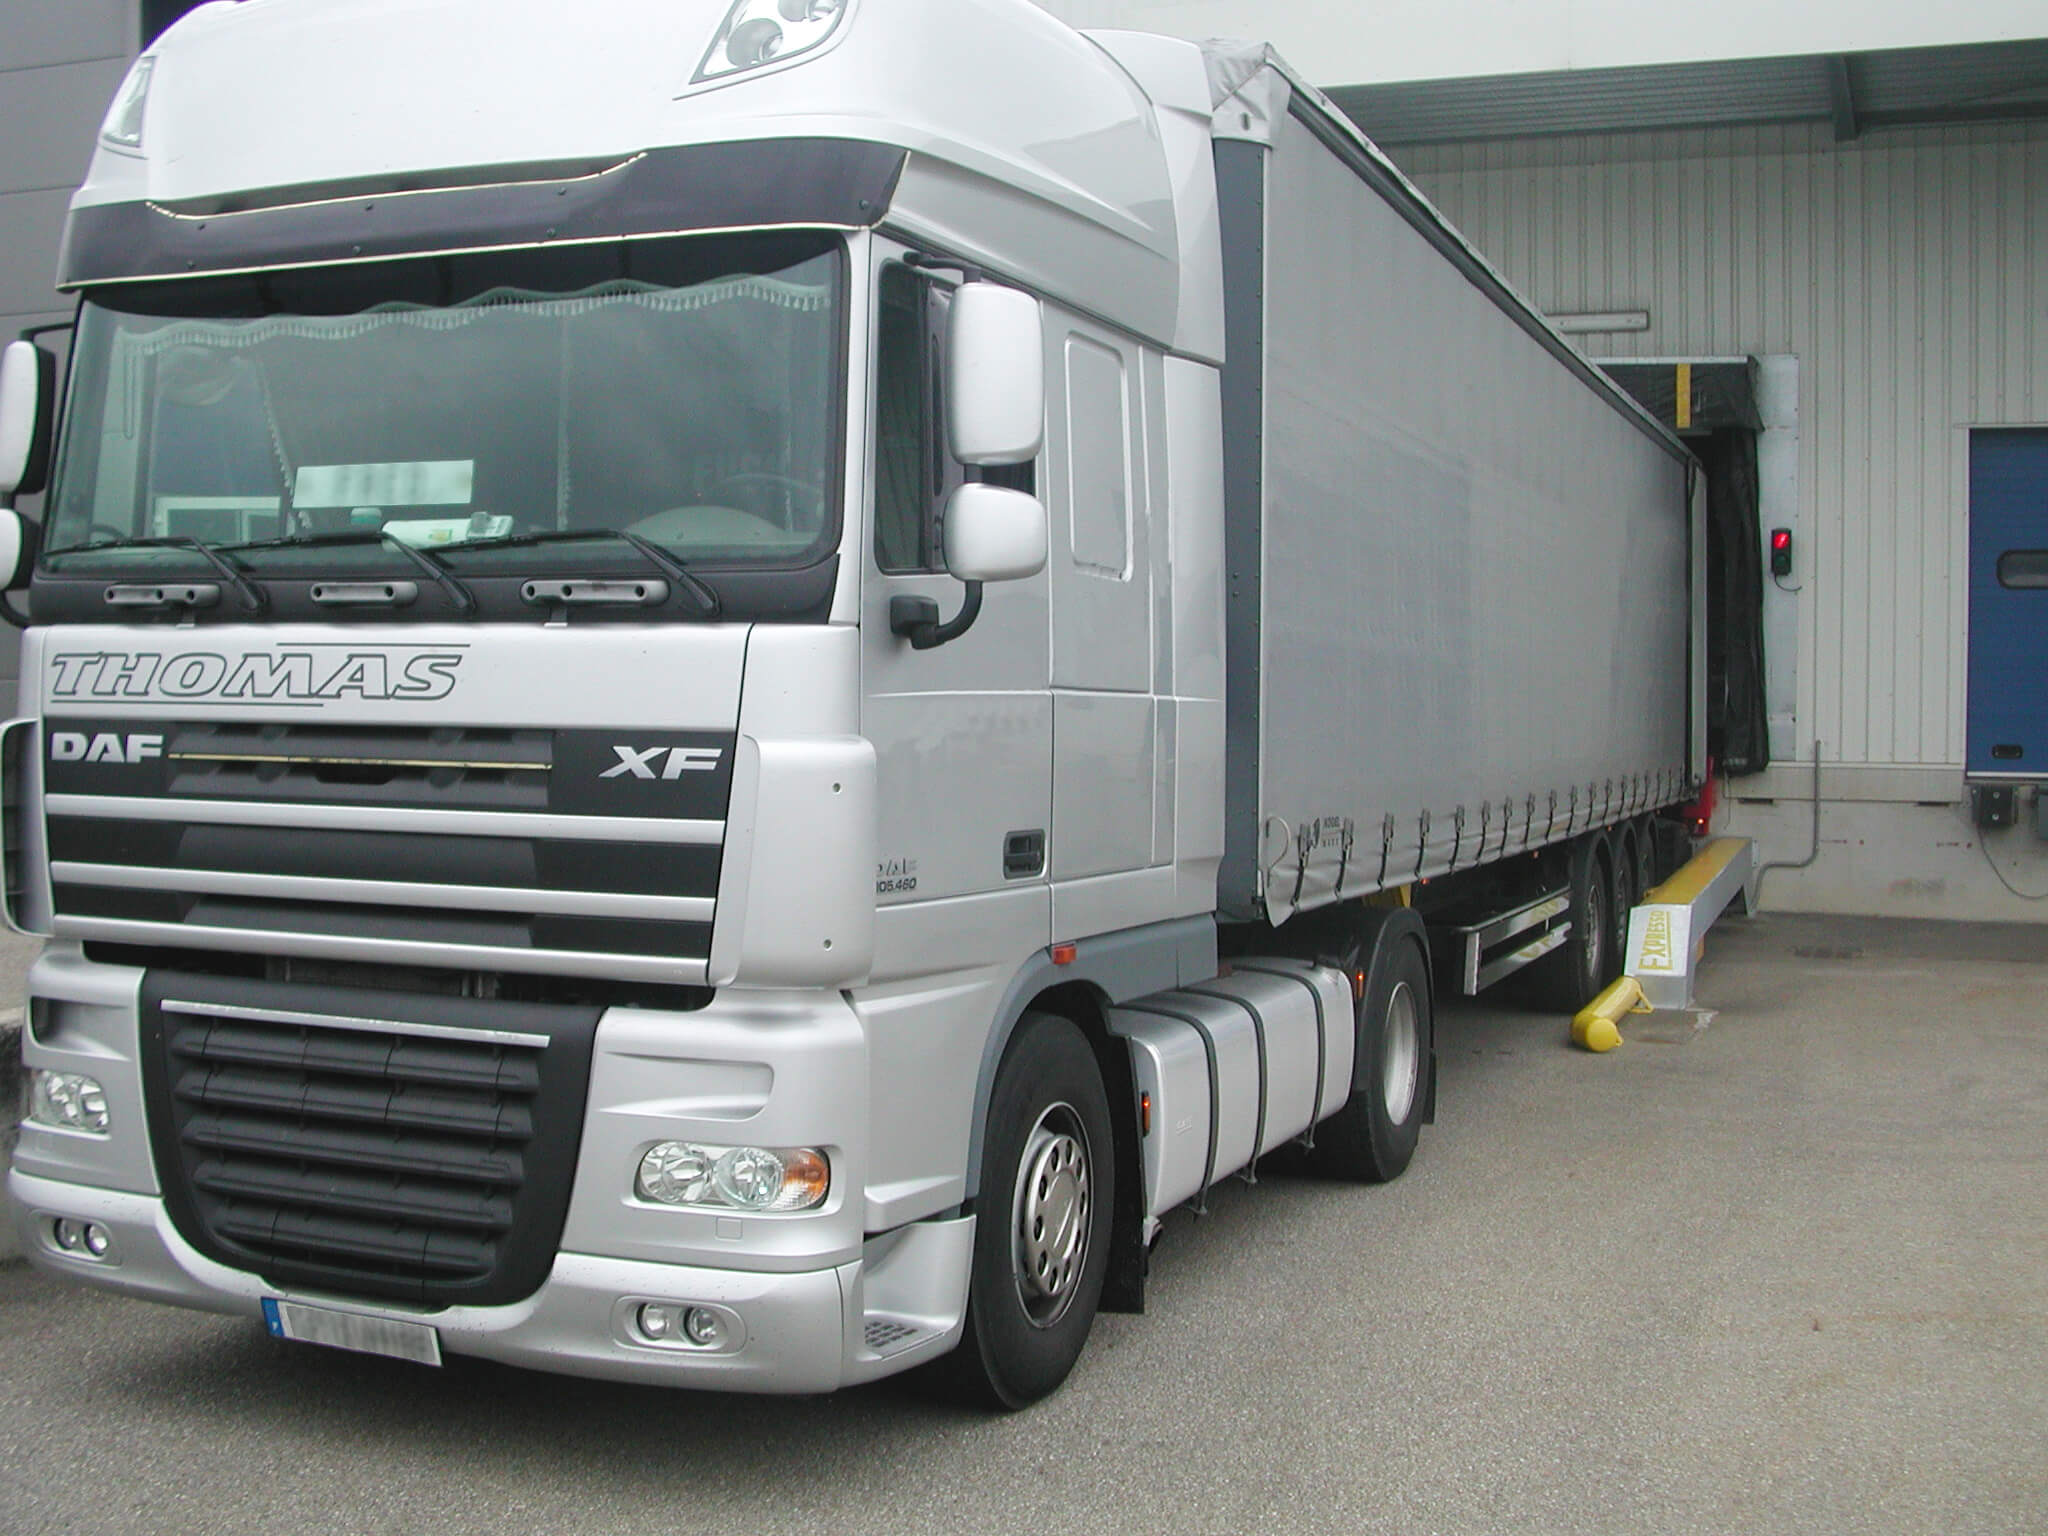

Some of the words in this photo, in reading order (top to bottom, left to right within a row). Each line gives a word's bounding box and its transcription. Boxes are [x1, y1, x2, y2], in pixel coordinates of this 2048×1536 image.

[51, 652, 463, 700] THOMAS
[51, 732, 164, 764] DAF
[598, 745, 722, 780] XF
[1638, 910, 1673, 970] EXPRESSO
